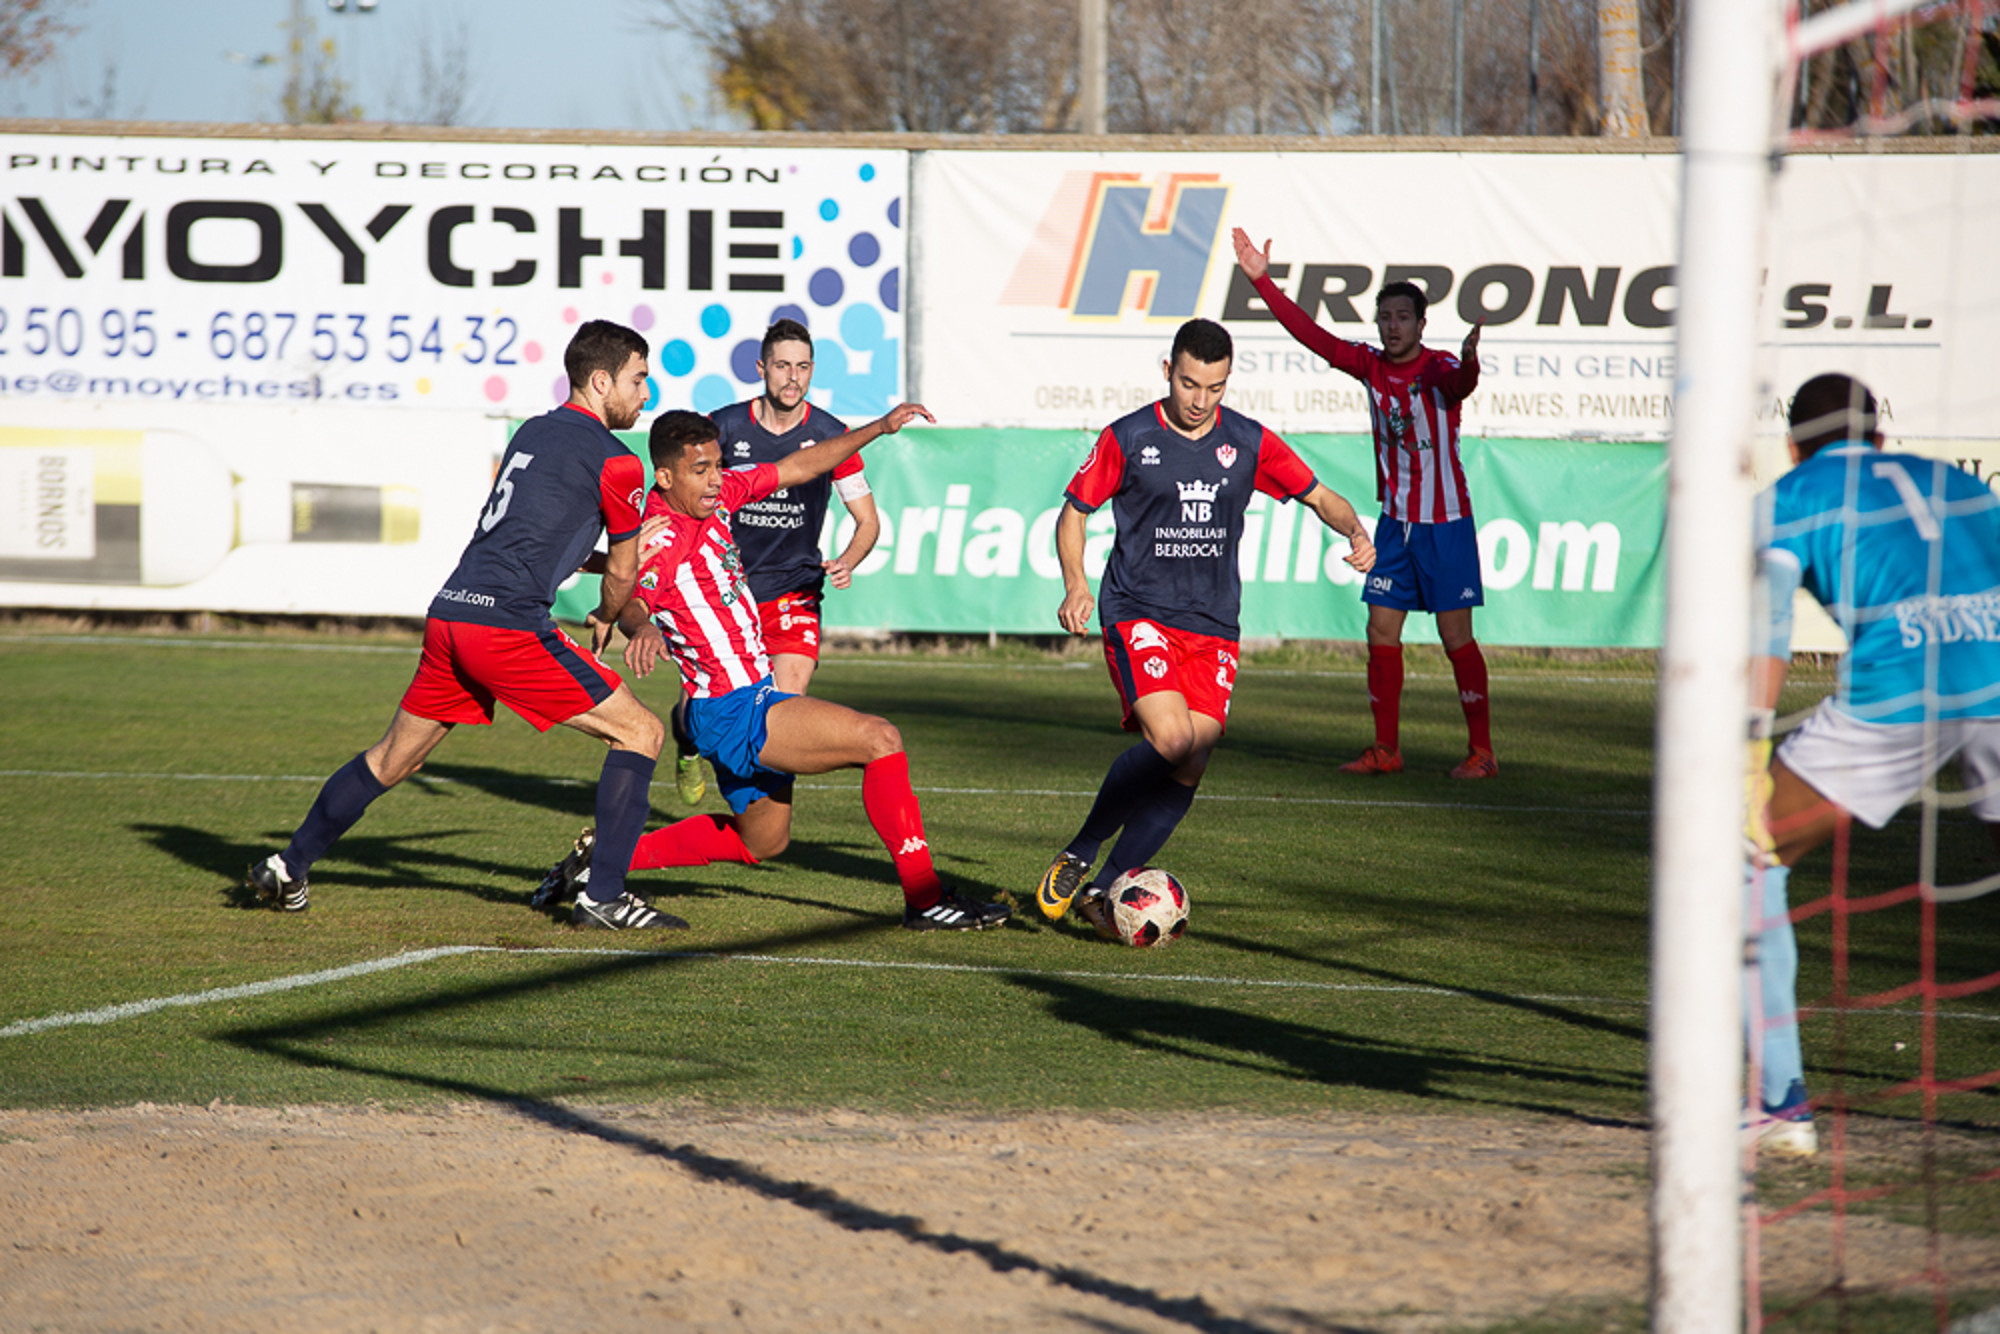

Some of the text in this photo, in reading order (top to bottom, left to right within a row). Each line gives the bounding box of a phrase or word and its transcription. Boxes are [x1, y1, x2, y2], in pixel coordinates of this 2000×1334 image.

[9, 154, 779, 184] PINTURA Y DECORACIÓN
[2, 197, 785, 292] MOYCHE
[1781, 283, 1934, 330] S.L.
[25, 306, 83, 358] 50
[100, 308, 157, 358] 95
[210, 311, 297, 360] 687
[311, 313, 369, 363] 53
[387, 315, 444, 363] 54
[462, 316, 518, 365] 32
[1513, 354, 1562, 378] EN
[1575, 355, 1678, 379] GENE
[1034, 384, 1097, 410] OBRA
[1578, 393, 1677, 419] PAVIMEN
[36, 455, 68, 549] BORNOS
[481, 451, 536, 533] 5
[1181, 502, 1213, 523] NB
[1871, 461, 1942, 541] 1
